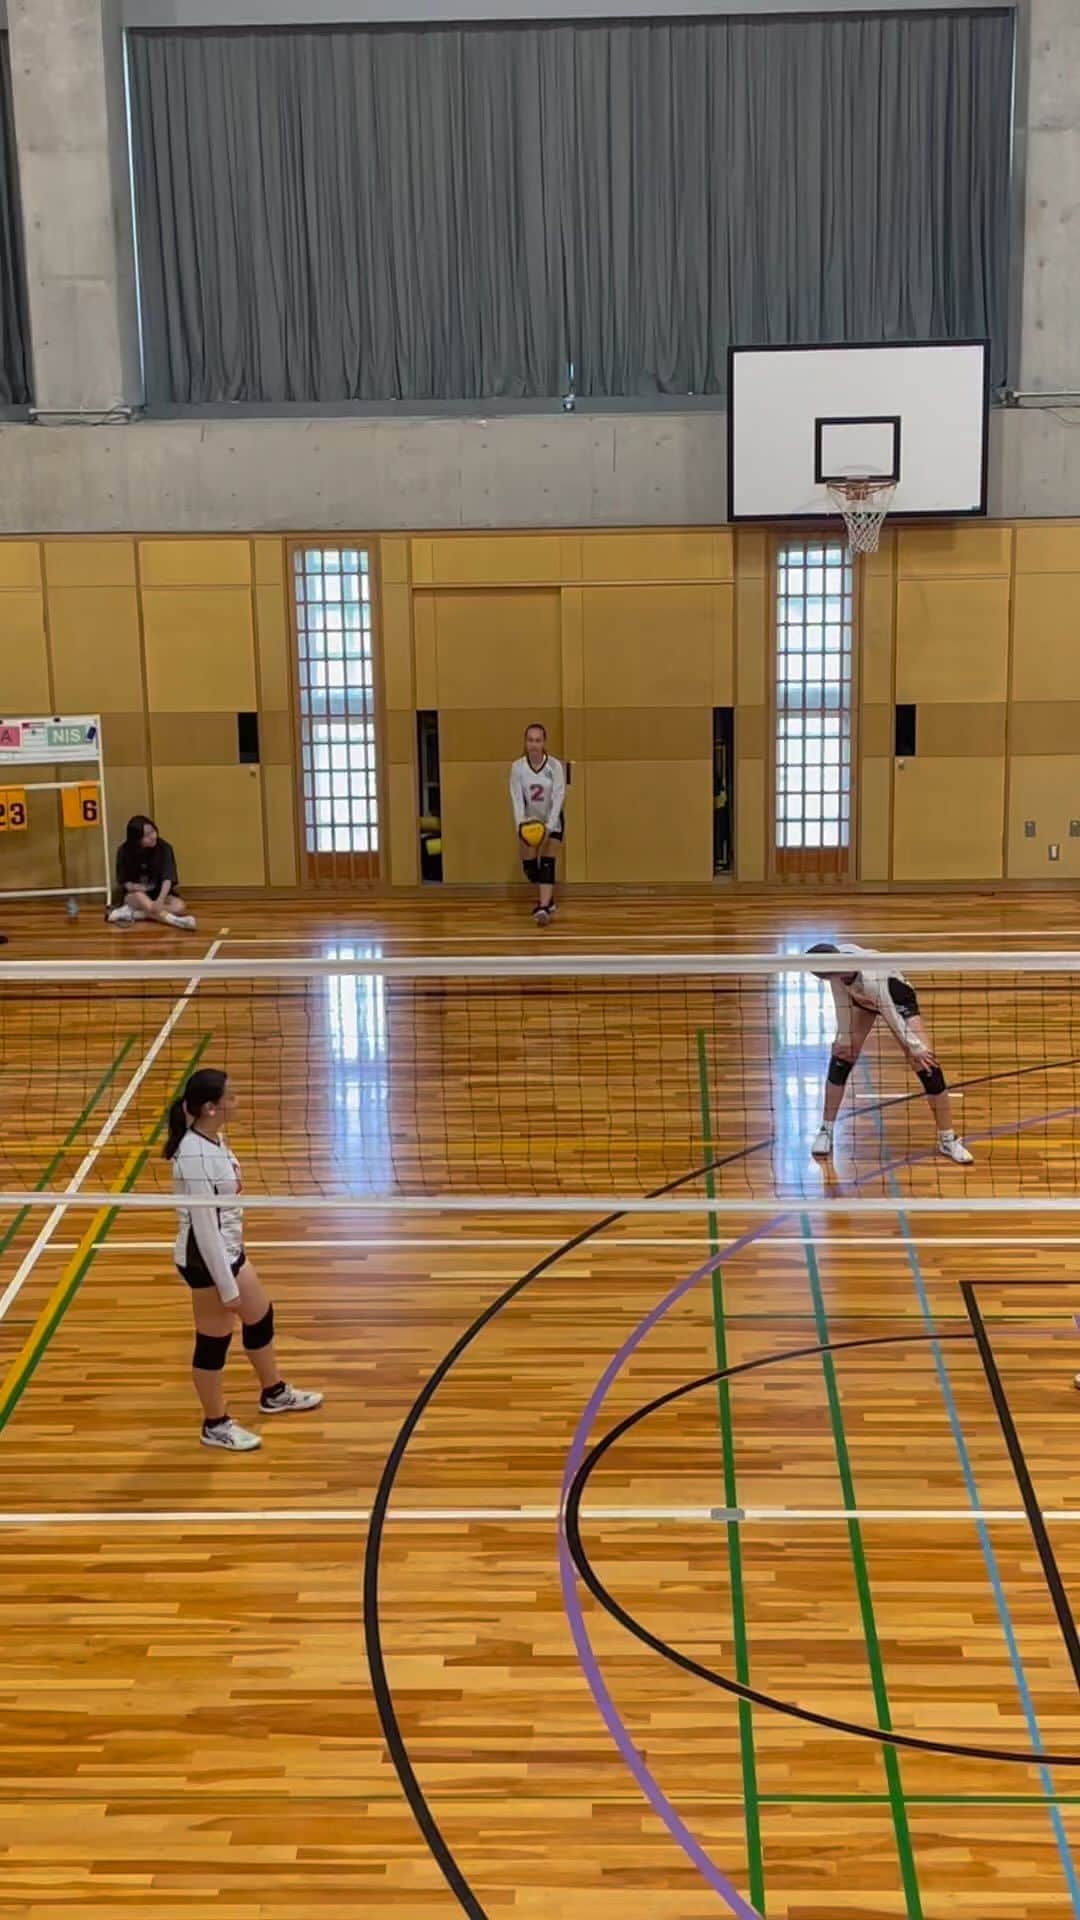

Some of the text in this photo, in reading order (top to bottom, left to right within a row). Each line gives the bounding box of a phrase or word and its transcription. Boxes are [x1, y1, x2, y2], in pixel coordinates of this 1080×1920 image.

[53, 728, 81, 744] NIS
[530, 784, 545, 802] 2
[83, 800, 97, 821] 6
